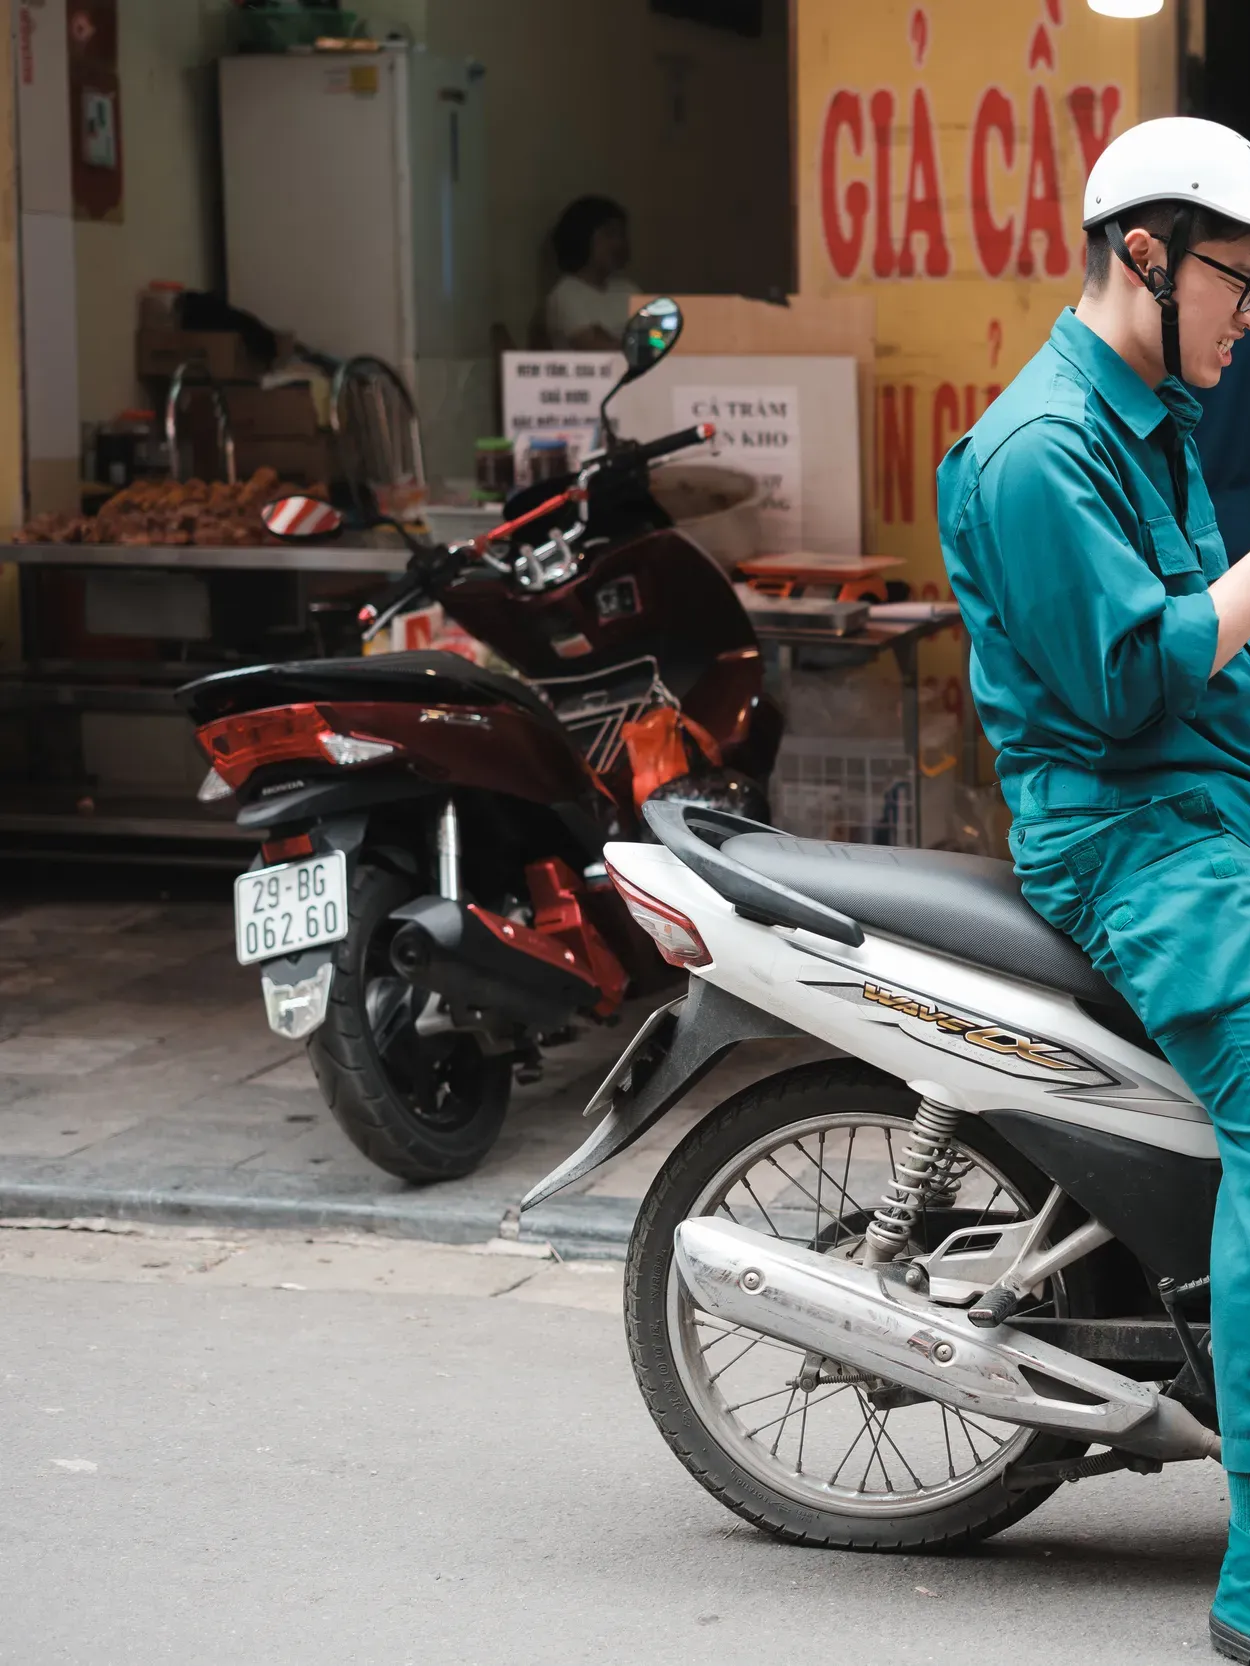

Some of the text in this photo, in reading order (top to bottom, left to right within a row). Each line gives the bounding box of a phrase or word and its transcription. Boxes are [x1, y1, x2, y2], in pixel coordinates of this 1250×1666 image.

[821, 8, 951, 278] GIẢ
[742, 430, 789, 448] KHO
[246, 901, 338, 954] 062.60
